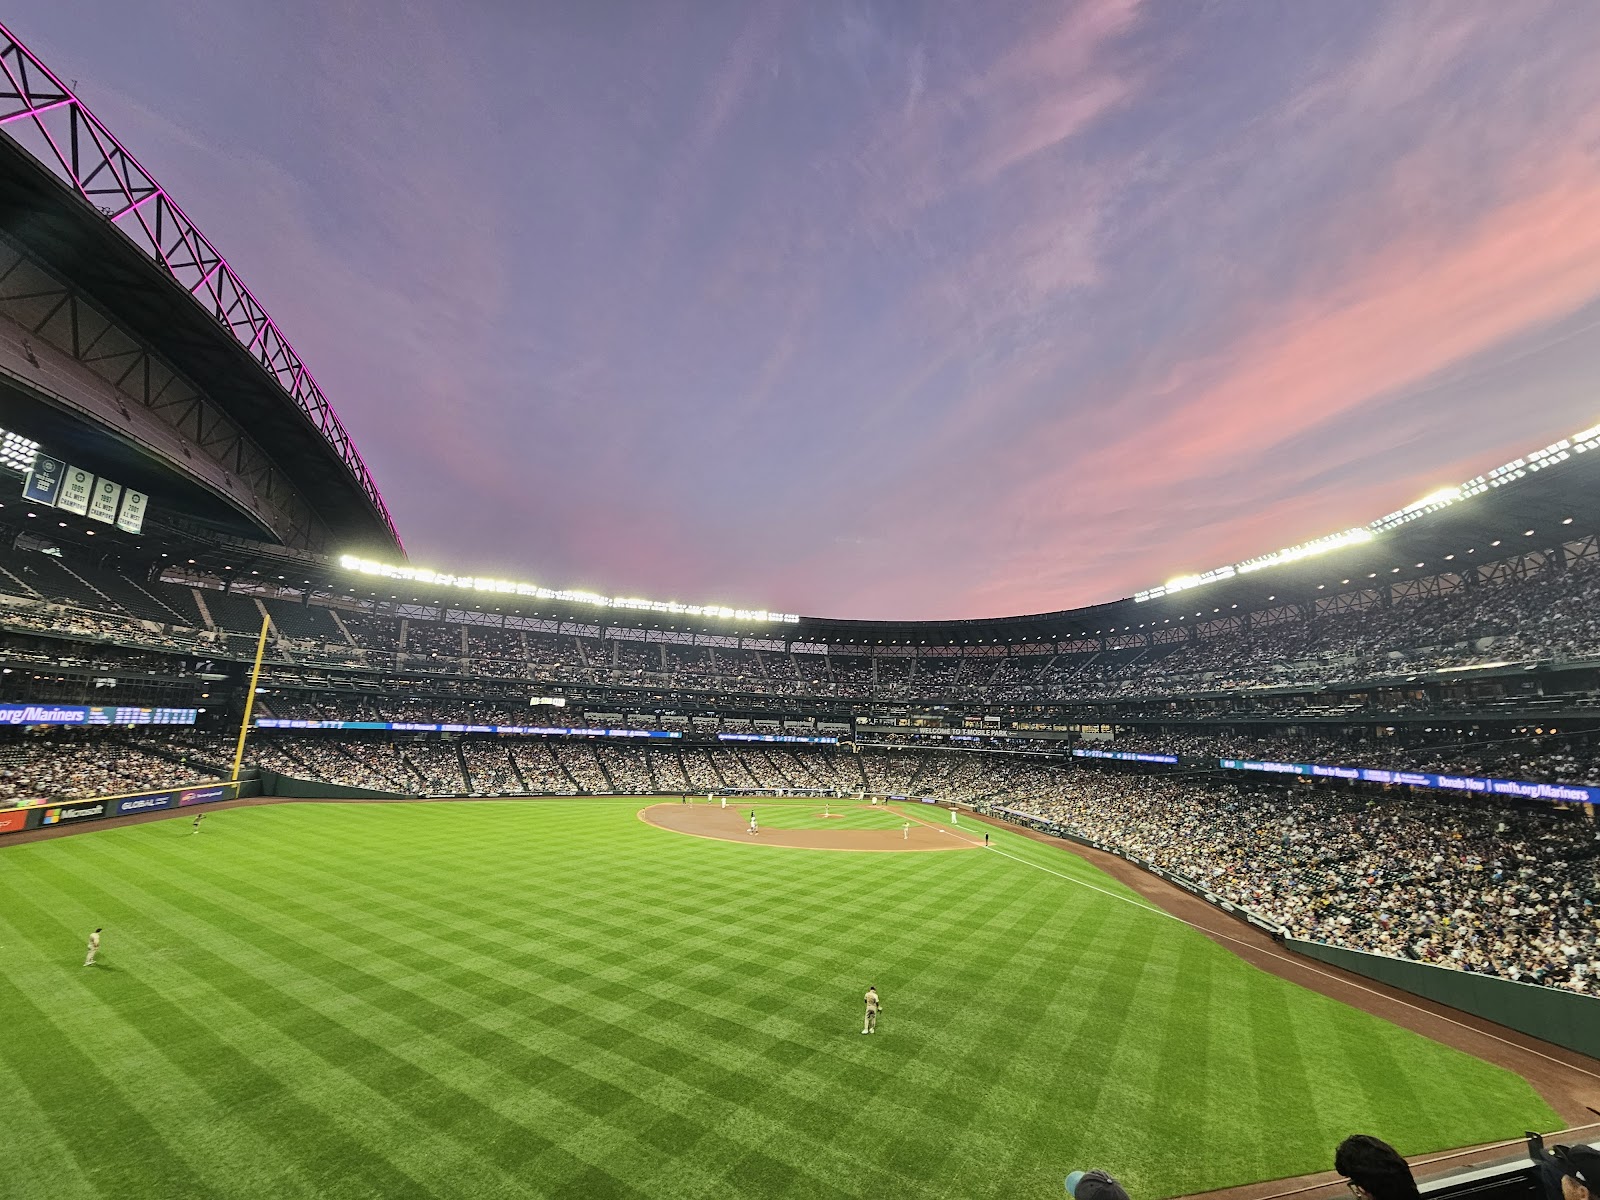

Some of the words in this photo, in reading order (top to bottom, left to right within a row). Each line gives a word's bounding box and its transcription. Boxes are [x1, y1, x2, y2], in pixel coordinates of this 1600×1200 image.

[0, 707, 85, 724] org/Mariners
[920, 727, 951, 735] WELCOME
[962, 728, 990, 736] T-MOBILE
[991, 729, 1008, 737] PARK
[1438, 776, 1465, 789] Donate
[1466, 778, 1485, 790] Now
[1495, 781, 1588, 801] vmfh.org/Mariners
[60, 804, 104, 819] Microsoft
